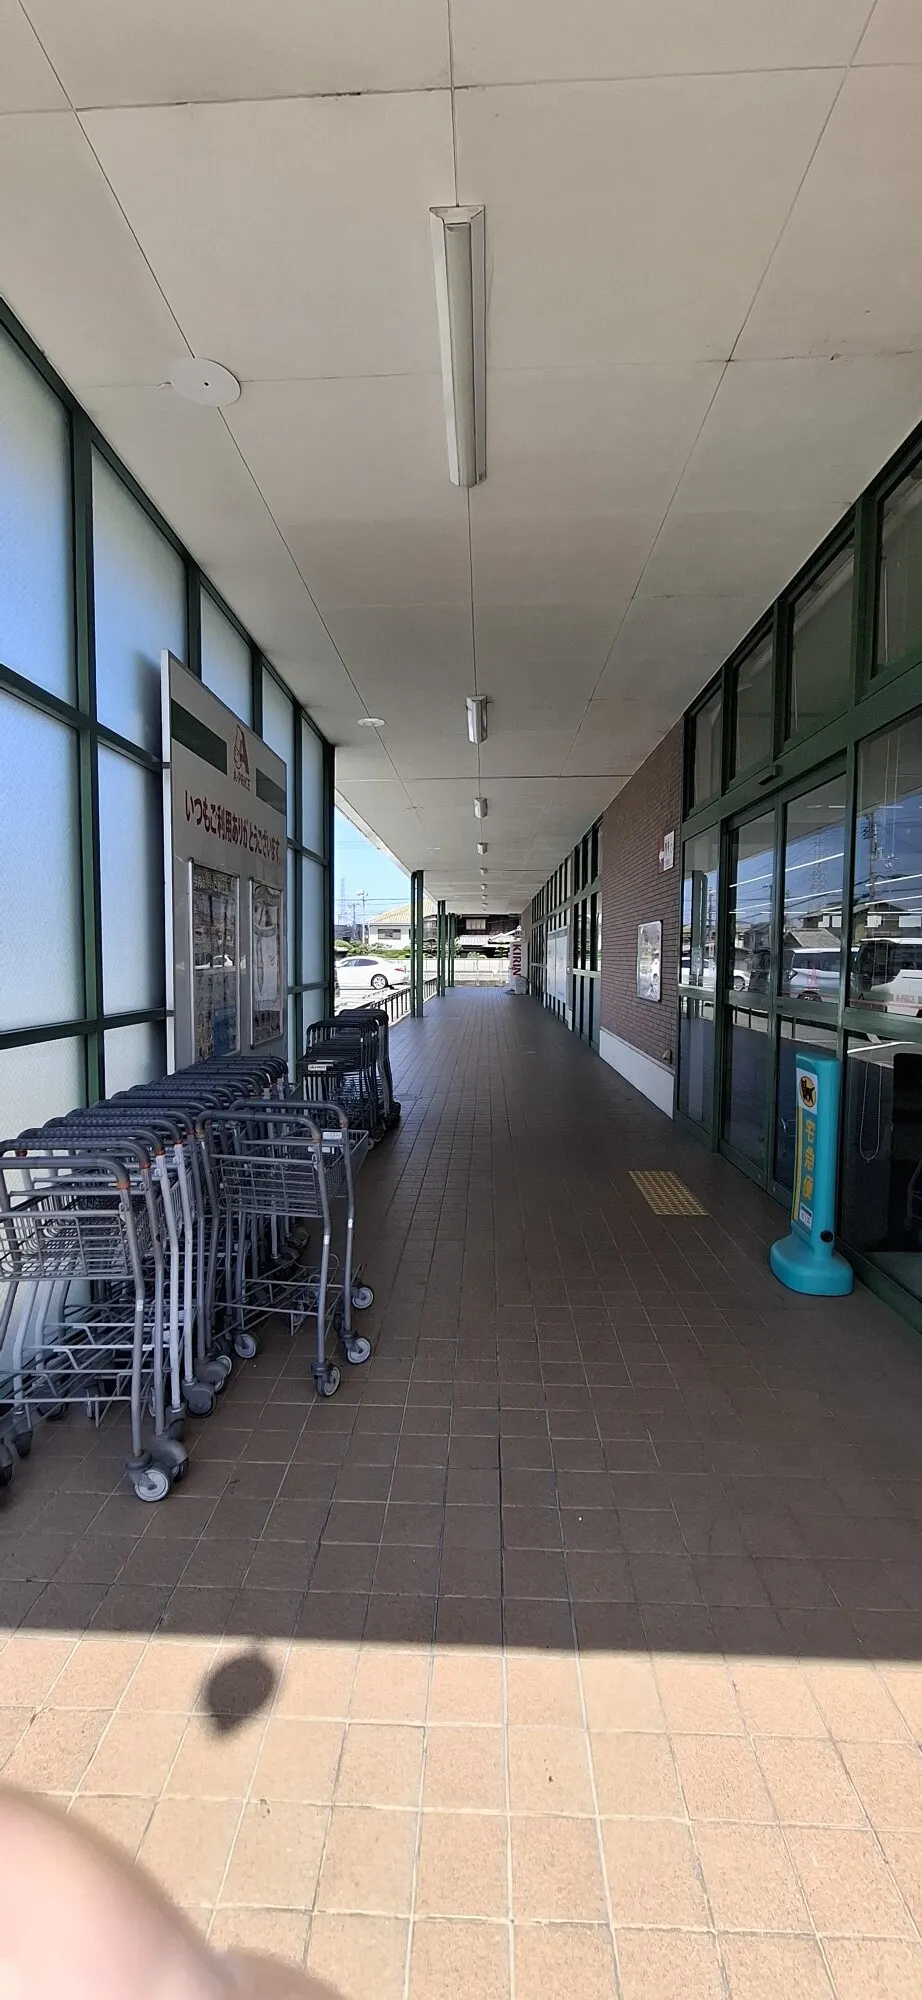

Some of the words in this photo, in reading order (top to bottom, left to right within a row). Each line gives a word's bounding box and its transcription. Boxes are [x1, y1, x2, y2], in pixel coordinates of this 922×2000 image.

[512, 944, 521, 976] KIRIN
[803, 1120, 815, 1200] 宅急便
